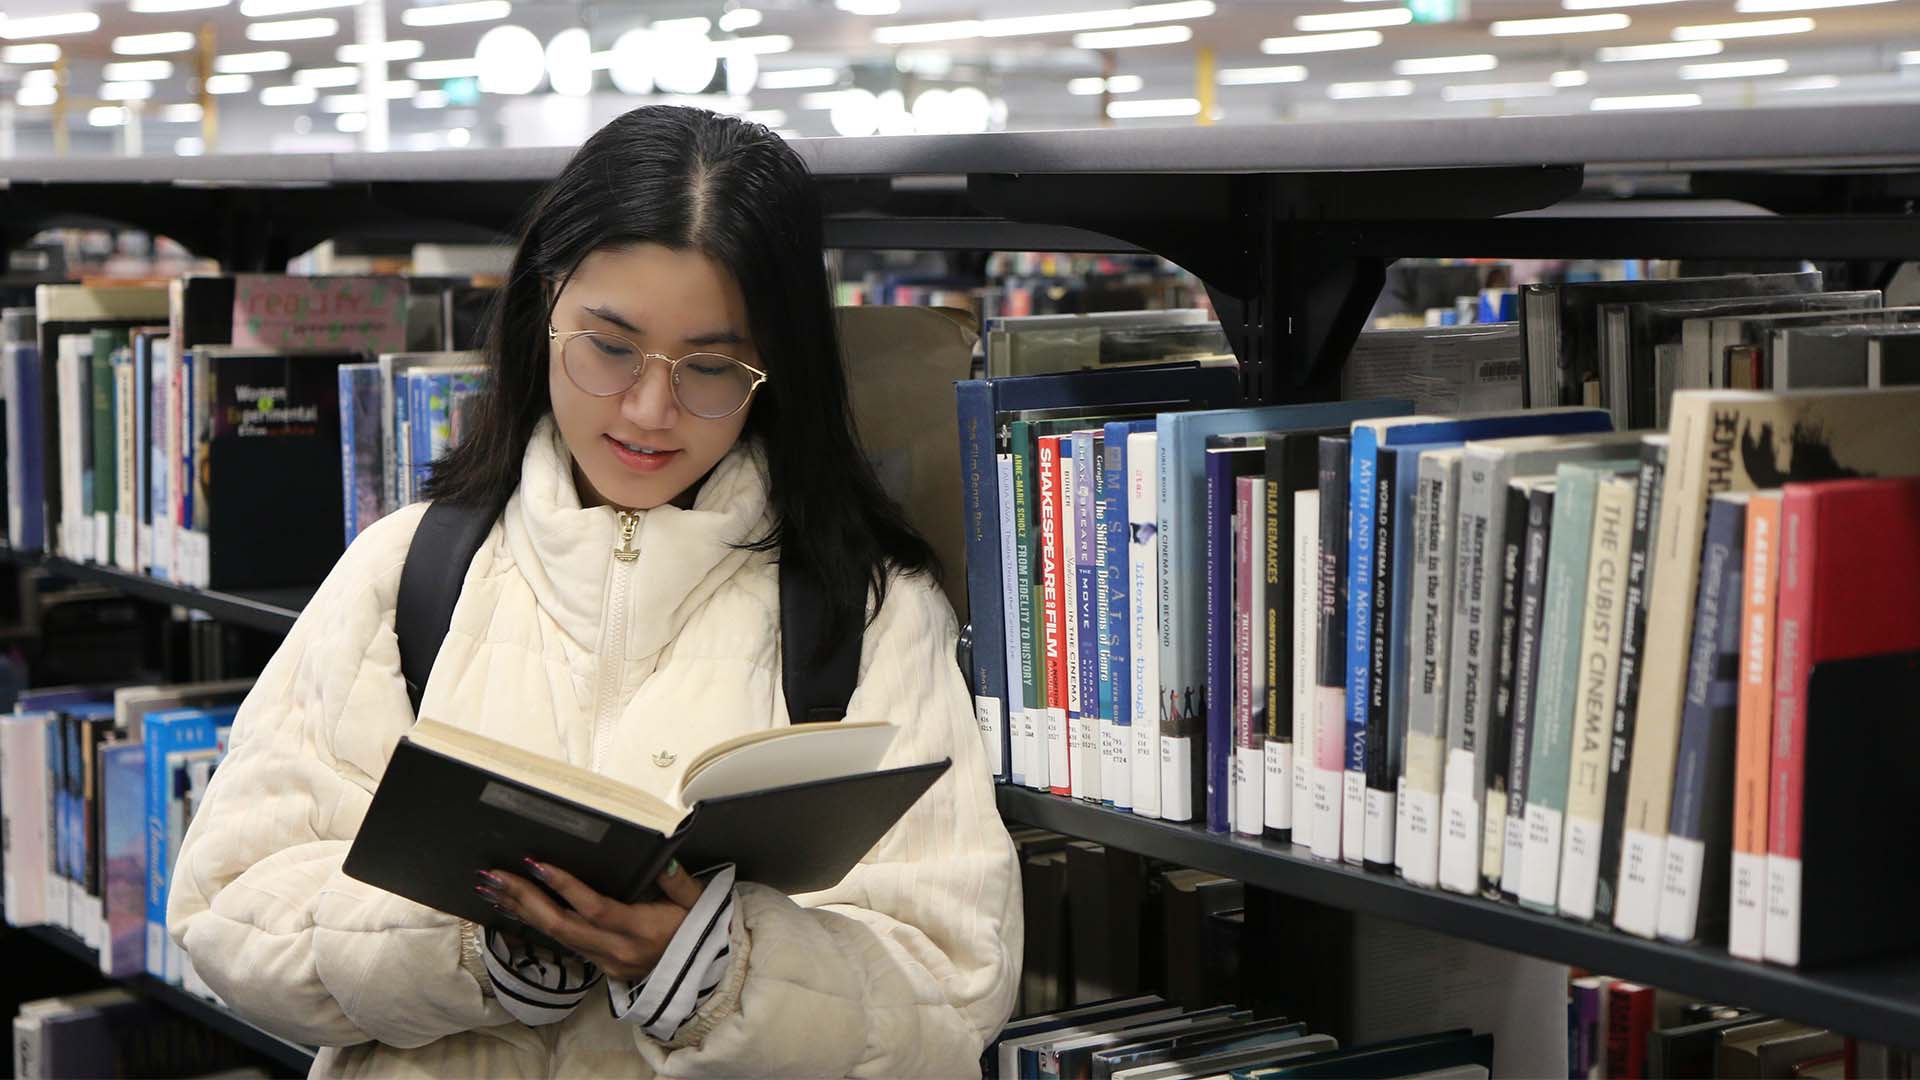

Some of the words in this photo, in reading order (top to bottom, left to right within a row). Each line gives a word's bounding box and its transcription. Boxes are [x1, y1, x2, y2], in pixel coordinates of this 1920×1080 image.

[1015, 454, 1025, 505] ANNE-MARIE
[1096, 455, 1105, 495] Geraghty
[1359, 459, 1371, 509] MYTH
[1096, 499, 1107, 519] The
[1266, 481, 1278, 514] FILM
[1379, 479, 1389, 525] WORLD
[1429, 479, 1443, 552] Narration
[1016, 508, 1026, 538] SCHOLZ
[1041, 447, 1057, 601] SHAKESPEARE
[1095, 522, 1107, 567] Shifting
[1358, 518, 1370, 551] AND
[1600, 504, 1621, 552] THE
[1017, 544, 1028, 575] FROM
[1162, 534, 1170, 575] CINEMA
[1266, 517, 1278, 584] REMAKES
[1357, 554, 1369, 585] THE
[1377, 527, 1388, 577] CINEMA
[1428, 555, 1440, 572] in
[1470, 515, 1487, 601] Narration
[1018, 579, 1030, 623] FIDELITY
[1081, 577, 1091, 630] MOVIE
[1096, 569, 1110, 630] Definitions
[1135, 562, 1146, 651] Literature
[1163, 578, 1171, 601] AND
[1322, 553, 1336, 616] FUTURE
[1376, 580, 1385, 608] AND
[1428, 575, 1440, 599] the
[1592, 557, 1617, 648] CUBIST
[1021, 626, 1031, 639] TO
[1046, 610, 1058, 658] FILM
[1163, 604, 1171, 648] BEYOND
[1355, 590, 1369, 652] MOVIES
[1375, 611, 1385, 633] THE
[1425, 602, 1439, 656] Fiction
[1469, 606, 1482, 624] in
[1099, 633, 1111, 645] of
[1375, 637, 1384, 675] ESSAY
[1468, 629, 1481, 657] the
[1021, 642, 1033, 687] HISTORY
[1071, 651, 1079, 703] CINEMA
[1100, 649, 1112, 682] Genre
[1241, 656, 1250, 685] DARE
[1424, 658, 1437, 695] Film
[1135, 655, 1146, 720] through
[1241, 688, 1250, 706] OR
[1353, 666, 1368, 727] STUART
[1374, 677, 1383, 707] FILM
[1463, 661, 1479, 724] Fiction
[1582, 651, 1608, 753] CINEMA
